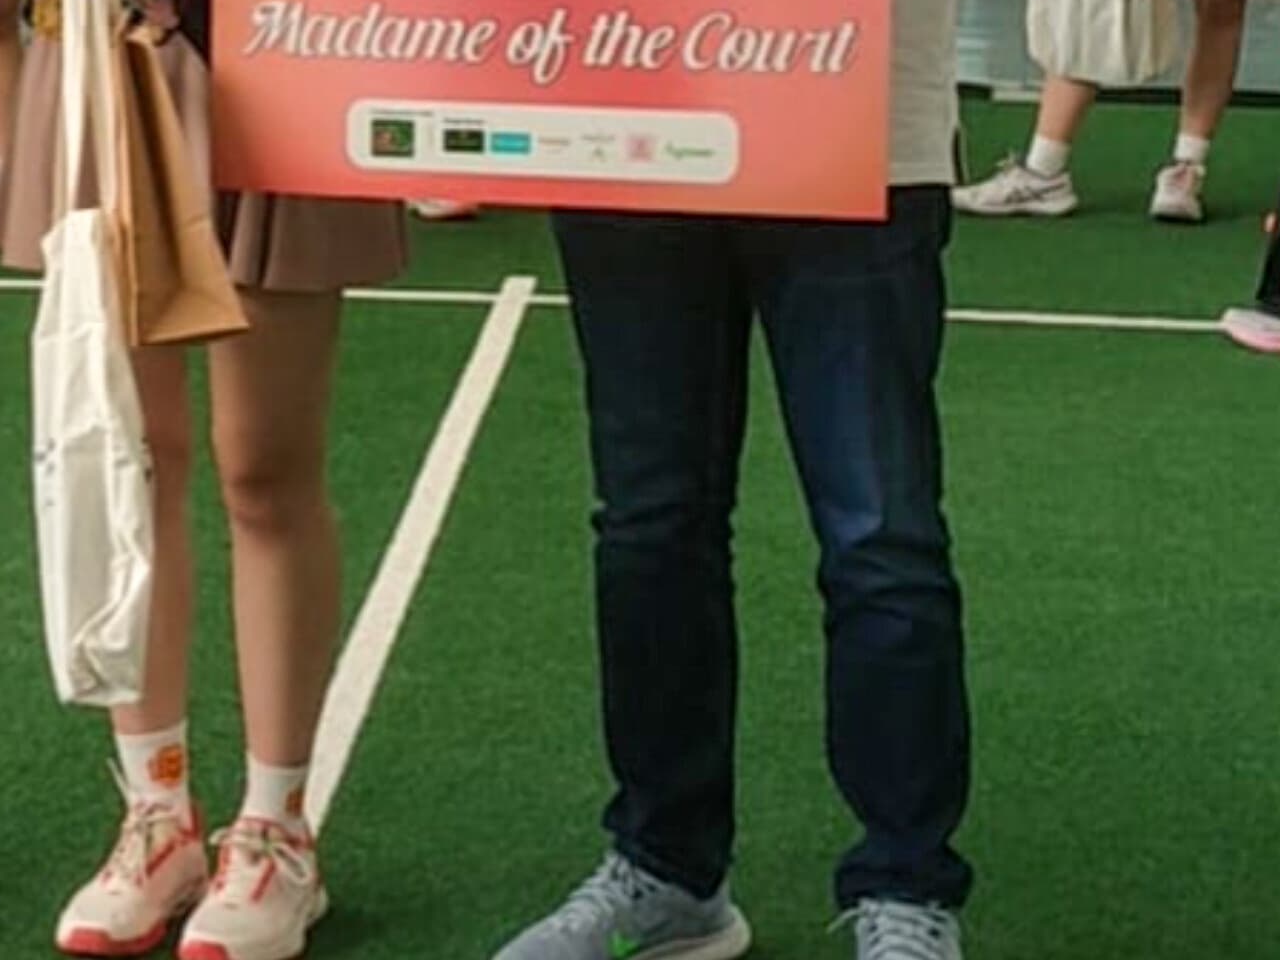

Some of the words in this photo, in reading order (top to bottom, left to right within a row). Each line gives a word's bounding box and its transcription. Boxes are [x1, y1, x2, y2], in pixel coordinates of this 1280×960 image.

[242, 0, 497, 64] Madame
[505, 8, 576, 84] of
[582, 11, 673, 69] the
[680, 12, 856, 74] Court
